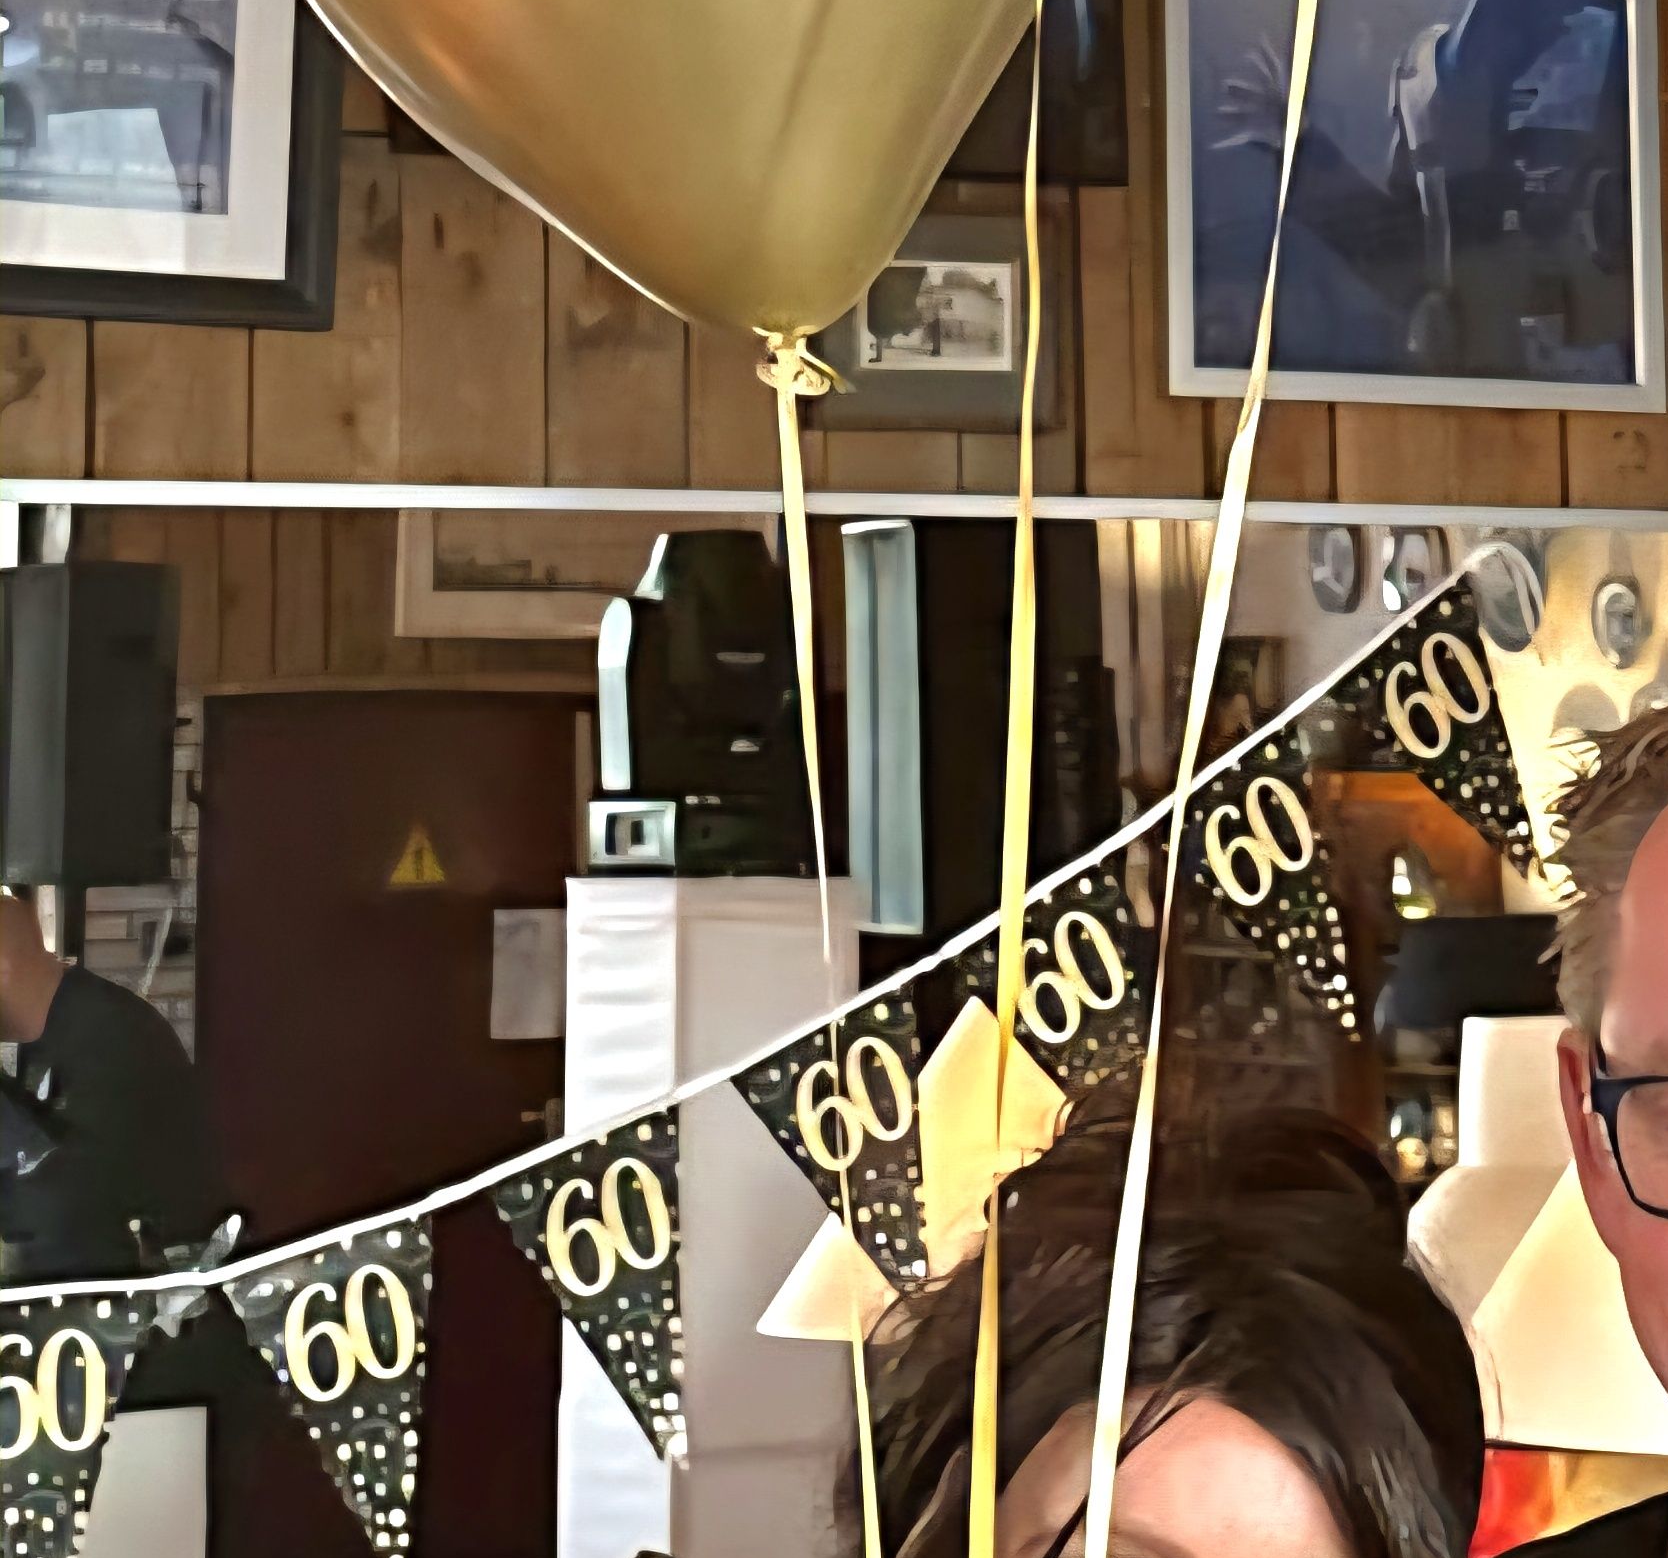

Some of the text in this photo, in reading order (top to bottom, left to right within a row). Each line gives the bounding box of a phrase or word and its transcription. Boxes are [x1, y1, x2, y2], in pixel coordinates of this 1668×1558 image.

[1386, 632, 1490, 759] 60
[1205, 776, 1313, 906] 60
[1018, 910, 1126, 1044] 60
[795, 1036, 912, 1172] 60
[546, 1157, 671, 1297] 60
[284, 1264, 416, 1403] 60
